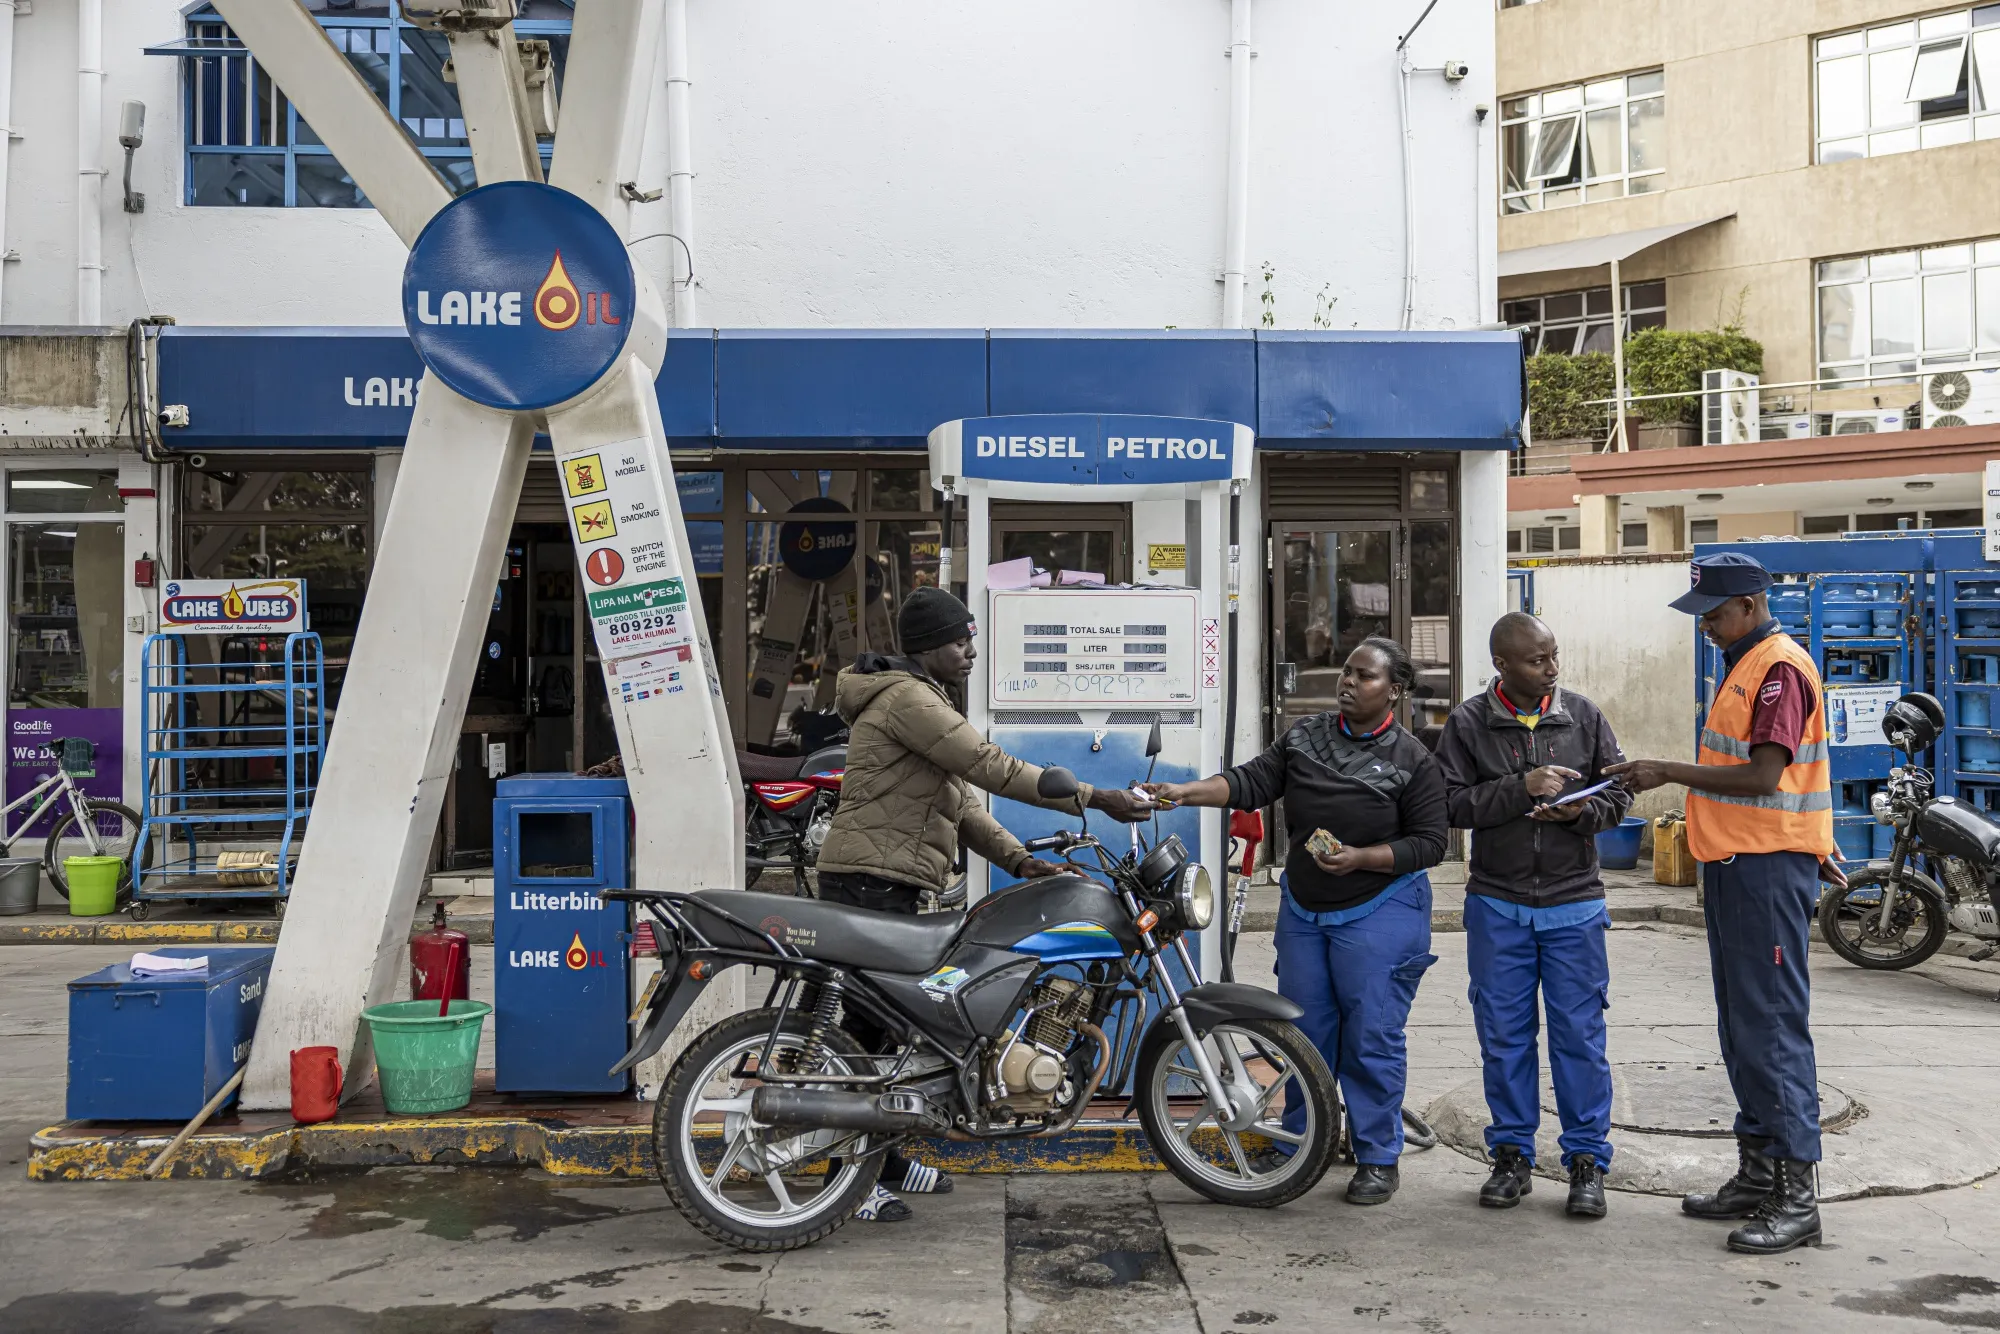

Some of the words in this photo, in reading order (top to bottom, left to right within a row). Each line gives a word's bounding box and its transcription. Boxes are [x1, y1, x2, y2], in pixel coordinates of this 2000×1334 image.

[417, 290, 521, 326] LAKE
[976, 436, 1085, 458] DIESEL
[1107, 437, 1226, 460] PETROL
[622, 457, 635, 466] NO
[615, 464, 646, 477] MOBILE
[631, 502, 645, 511] NO
[620, 508, 660, 524] SMOKING
[630, 541, 664, 555] SWITCH
[632, 553, 648, 564] OFF
[649, 550, 666, 561] THE
[636, 560, 667, 573] ENGINE
[172, 601, 218, 617] LAKE
[595, 596, 615, 610] LIPA
[617, 595, 631, 607] NA
[598, 616, 611, 625] BUY
[614, 612, 639, 623] GOODS
[640, 609, 654, 619] TILL
[655, 604, 687, 617] NUMBER
[194, 623, 234, 631] Committed
[236, 623, 244, 631] to
[246, 623, 272, 632] quality
[610, 614, 676, 636] 809292
[1070, 626, 1097, 634] TOTAL
[1099, 626, 1121, 634] SALE
[612, 634, 631, 645] LAKE
[632, 631, 644, 641] OIL
[645, 626, 677, 639] KILIMANI
[1083, 645, 1108, 653] LITER
[667, 684, 684, 694] VISA
[13, 747, 36, 760] We
[510, 891, 604, 911] Litterbin
[786, 927, 798, 936] You
[799, 927, 811, 937] like
[811, 929, 817, 938] it
[510, 950, 559, 968] LAKE
[240, 976, 262, 1004] Sand
